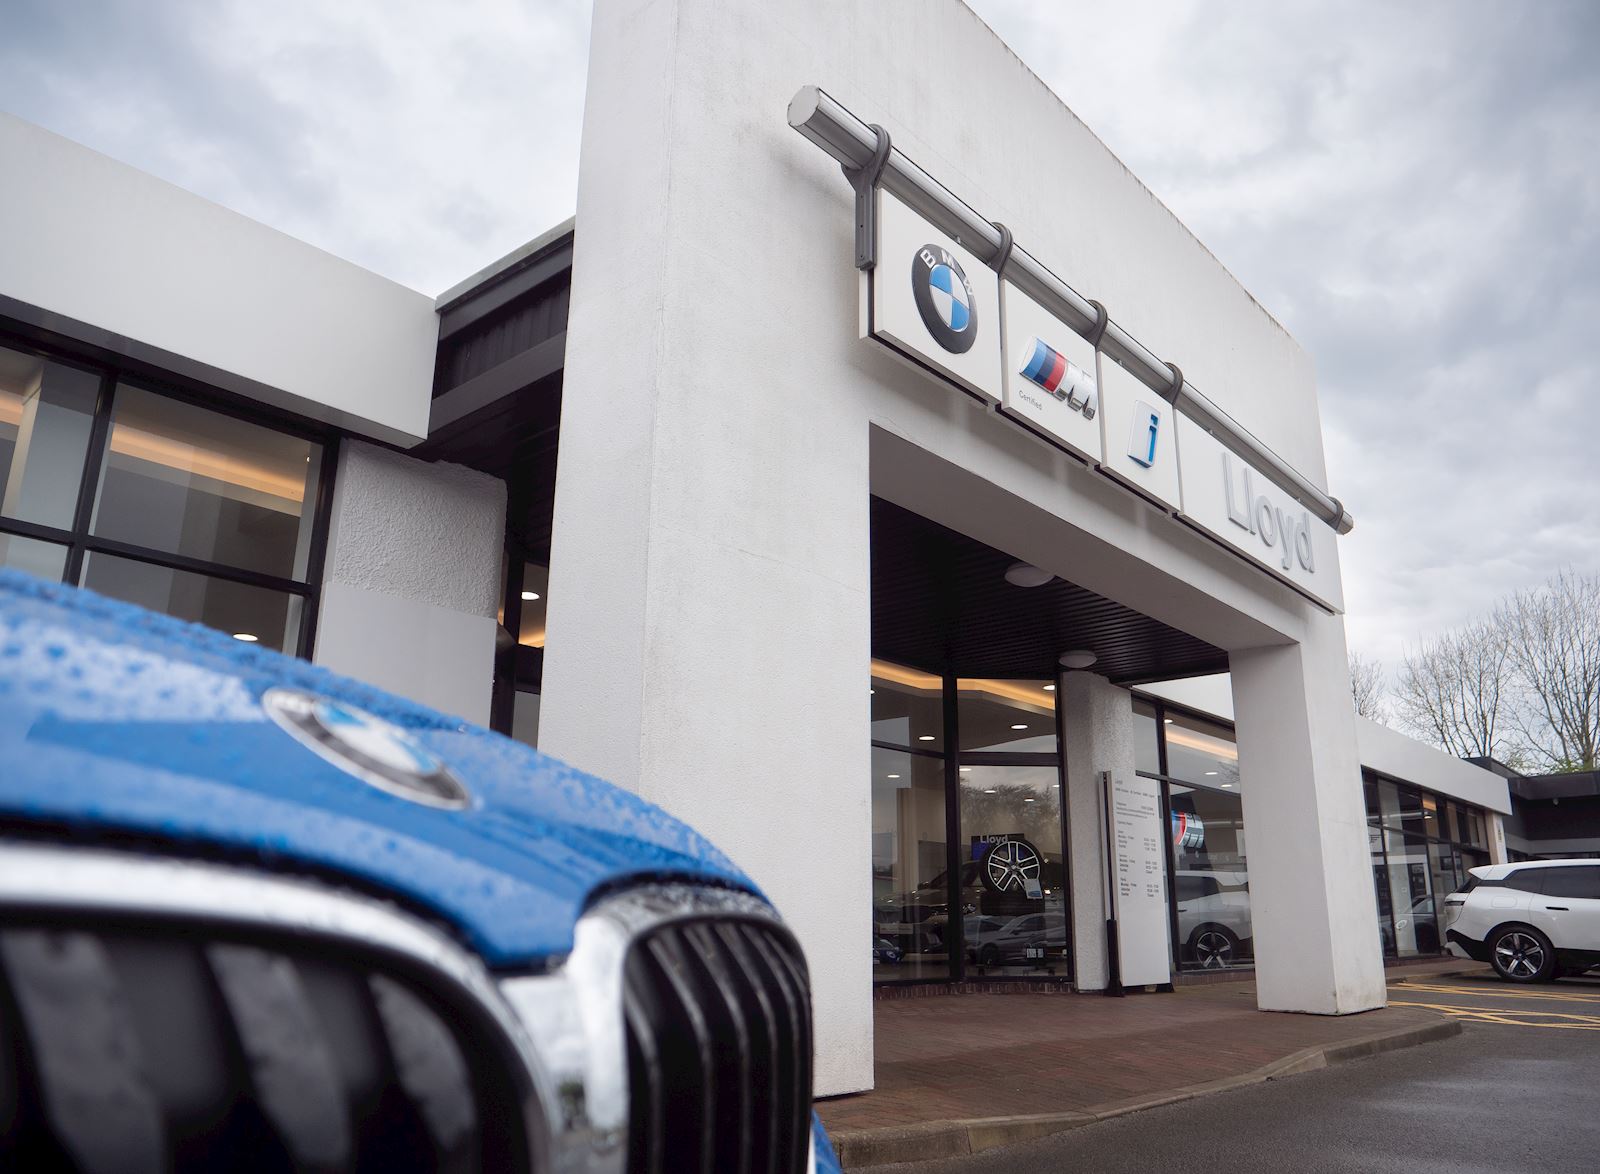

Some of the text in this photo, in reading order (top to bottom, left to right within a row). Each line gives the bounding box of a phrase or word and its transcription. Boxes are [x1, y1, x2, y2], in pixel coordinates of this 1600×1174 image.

[920, 249, 973, 296] BMW
[1221, 451, 1315, 574] Lloyd
[980, 834, 1008, 846] Lloyd
